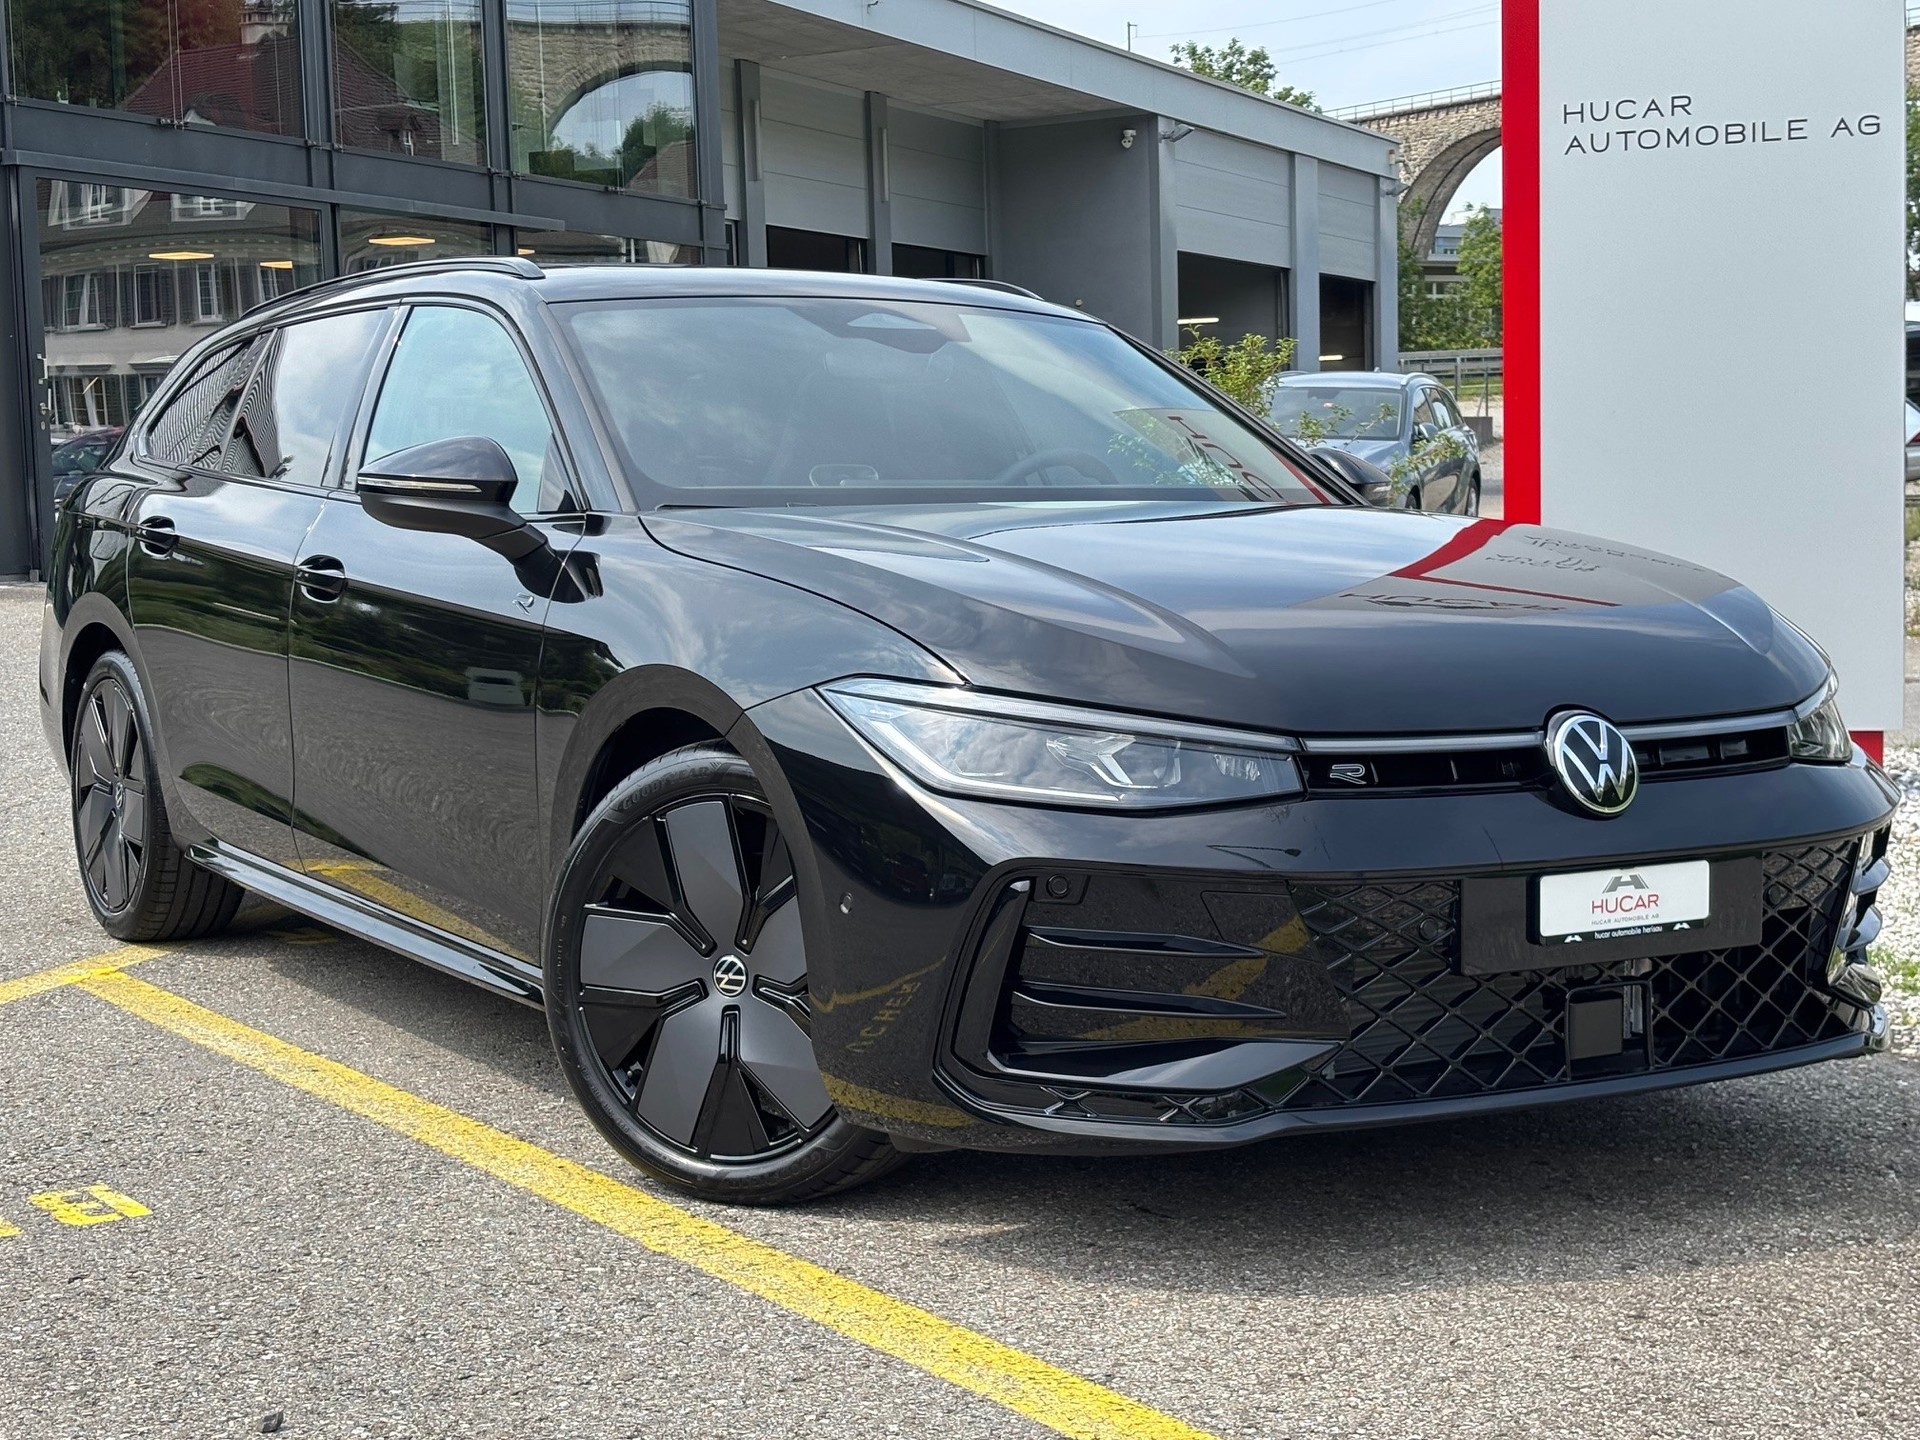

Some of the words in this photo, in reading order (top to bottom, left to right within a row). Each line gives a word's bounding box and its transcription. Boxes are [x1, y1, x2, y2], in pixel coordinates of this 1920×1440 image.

[1562, 94, 1693, 124] HUCAR
[1564, 118, 1809, 155] AUTOMOBILE
[1830, 115, 1882, 138] AG
[1591, 894, 1660, 914] HUCAR
[1591, 918, 1612, 926] HUCAR
[1614, 914, 1649, 923] AUTOMOBILE
[1594, 931, 1611, 940] hucar
[1611, 926, 1642, 938] automobile
